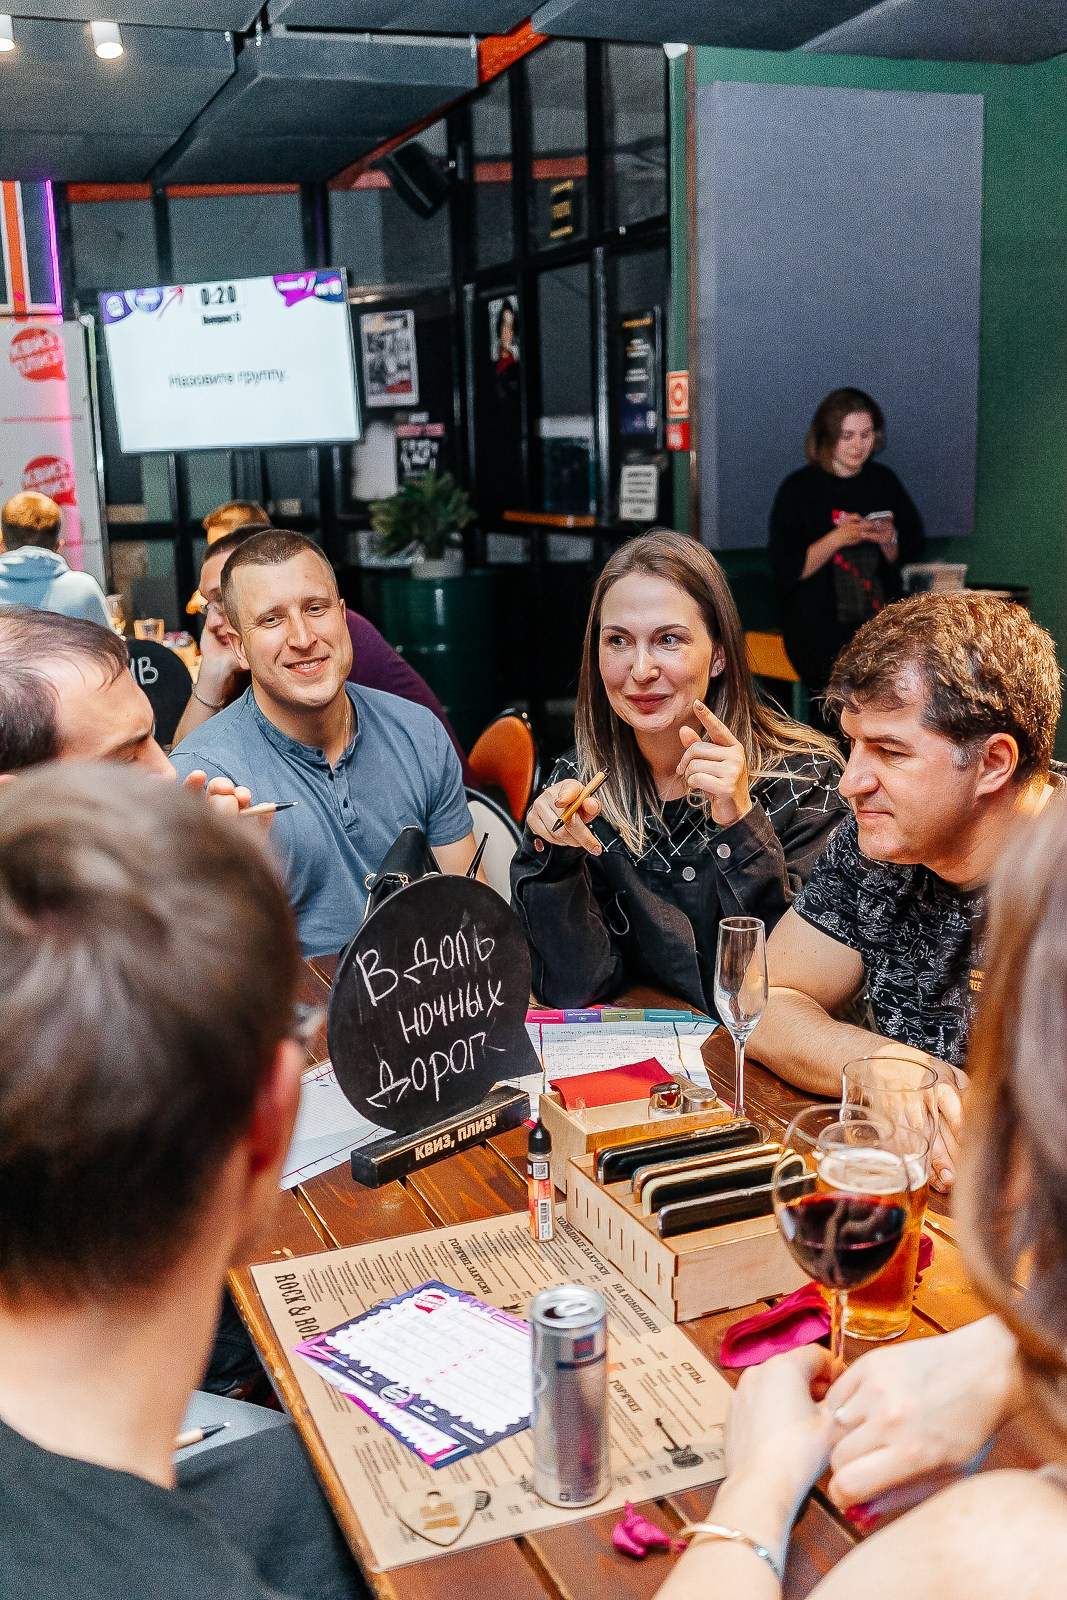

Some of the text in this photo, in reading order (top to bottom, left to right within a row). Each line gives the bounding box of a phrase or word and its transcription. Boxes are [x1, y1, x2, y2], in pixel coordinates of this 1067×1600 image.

[398, 979, 505, 1044] НОЧНЫХ
[366, 1031, 488, 1108] ДОРОГ
[415, 1113, 497, 1161] КВИЗ, ПЛИЗ!
[448, 1238, 493, 1295] ГОРЯЧИЕ ЗАКУСКИ
[556, 1215, 611, 1276] ХОЛОДНЫЕ ЗАКУСКИ
[275, 1273, 321, 1341] ROCK & ROL
[612, 1283, 623, 1295] НА
[621, 1293, 662, 1334] КОМПАНИЮ
[681, 1362, 706, 1385] СУПЫ
